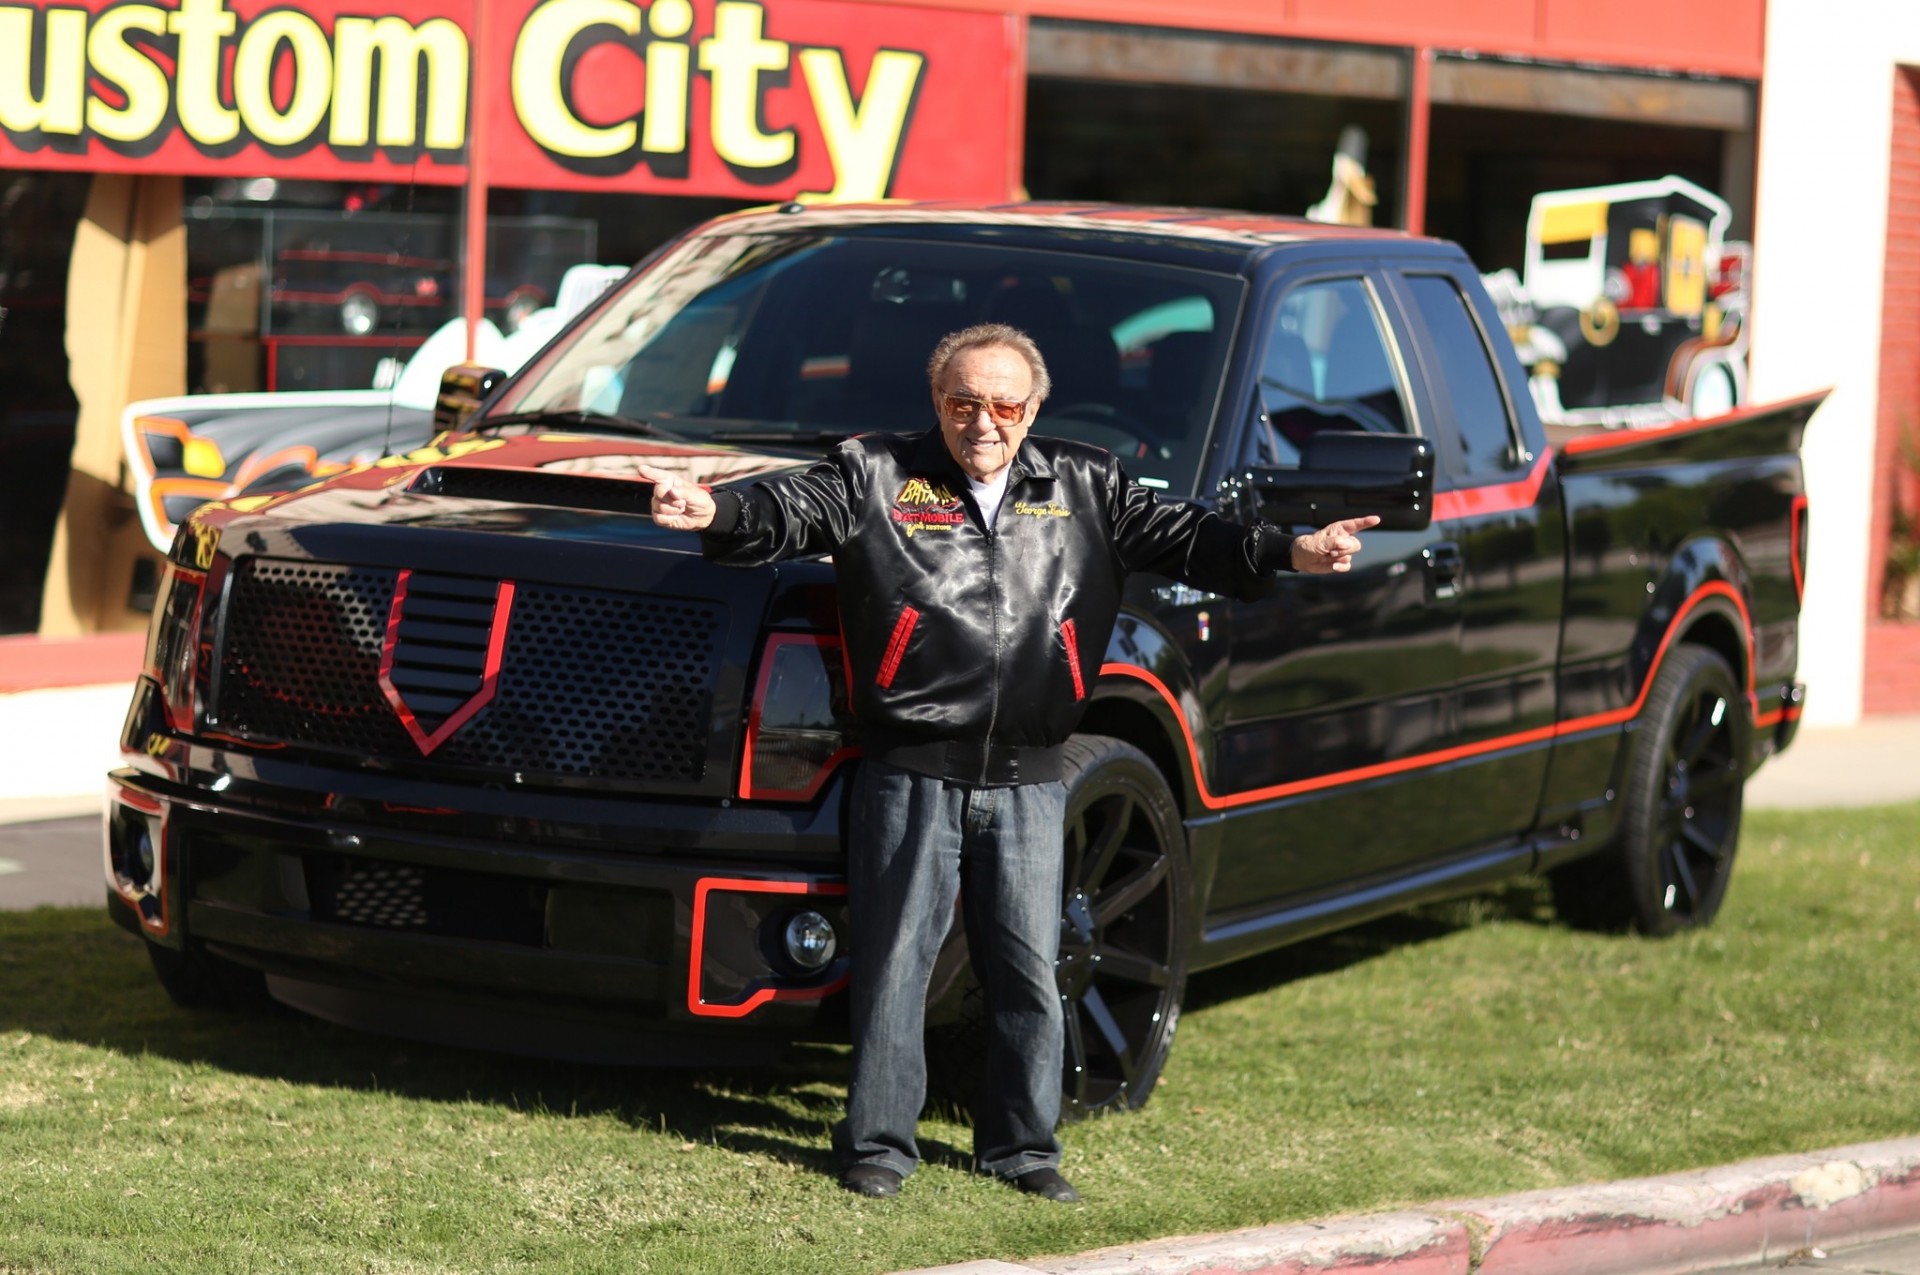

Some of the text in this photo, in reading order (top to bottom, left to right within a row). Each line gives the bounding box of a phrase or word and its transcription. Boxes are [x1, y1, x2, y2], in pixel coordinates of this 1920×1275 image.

[0, 0, 925, 204] ustom City
[892, 508, 964, 523] BATMOBILE
[1015, 501, 1047, 519] George
